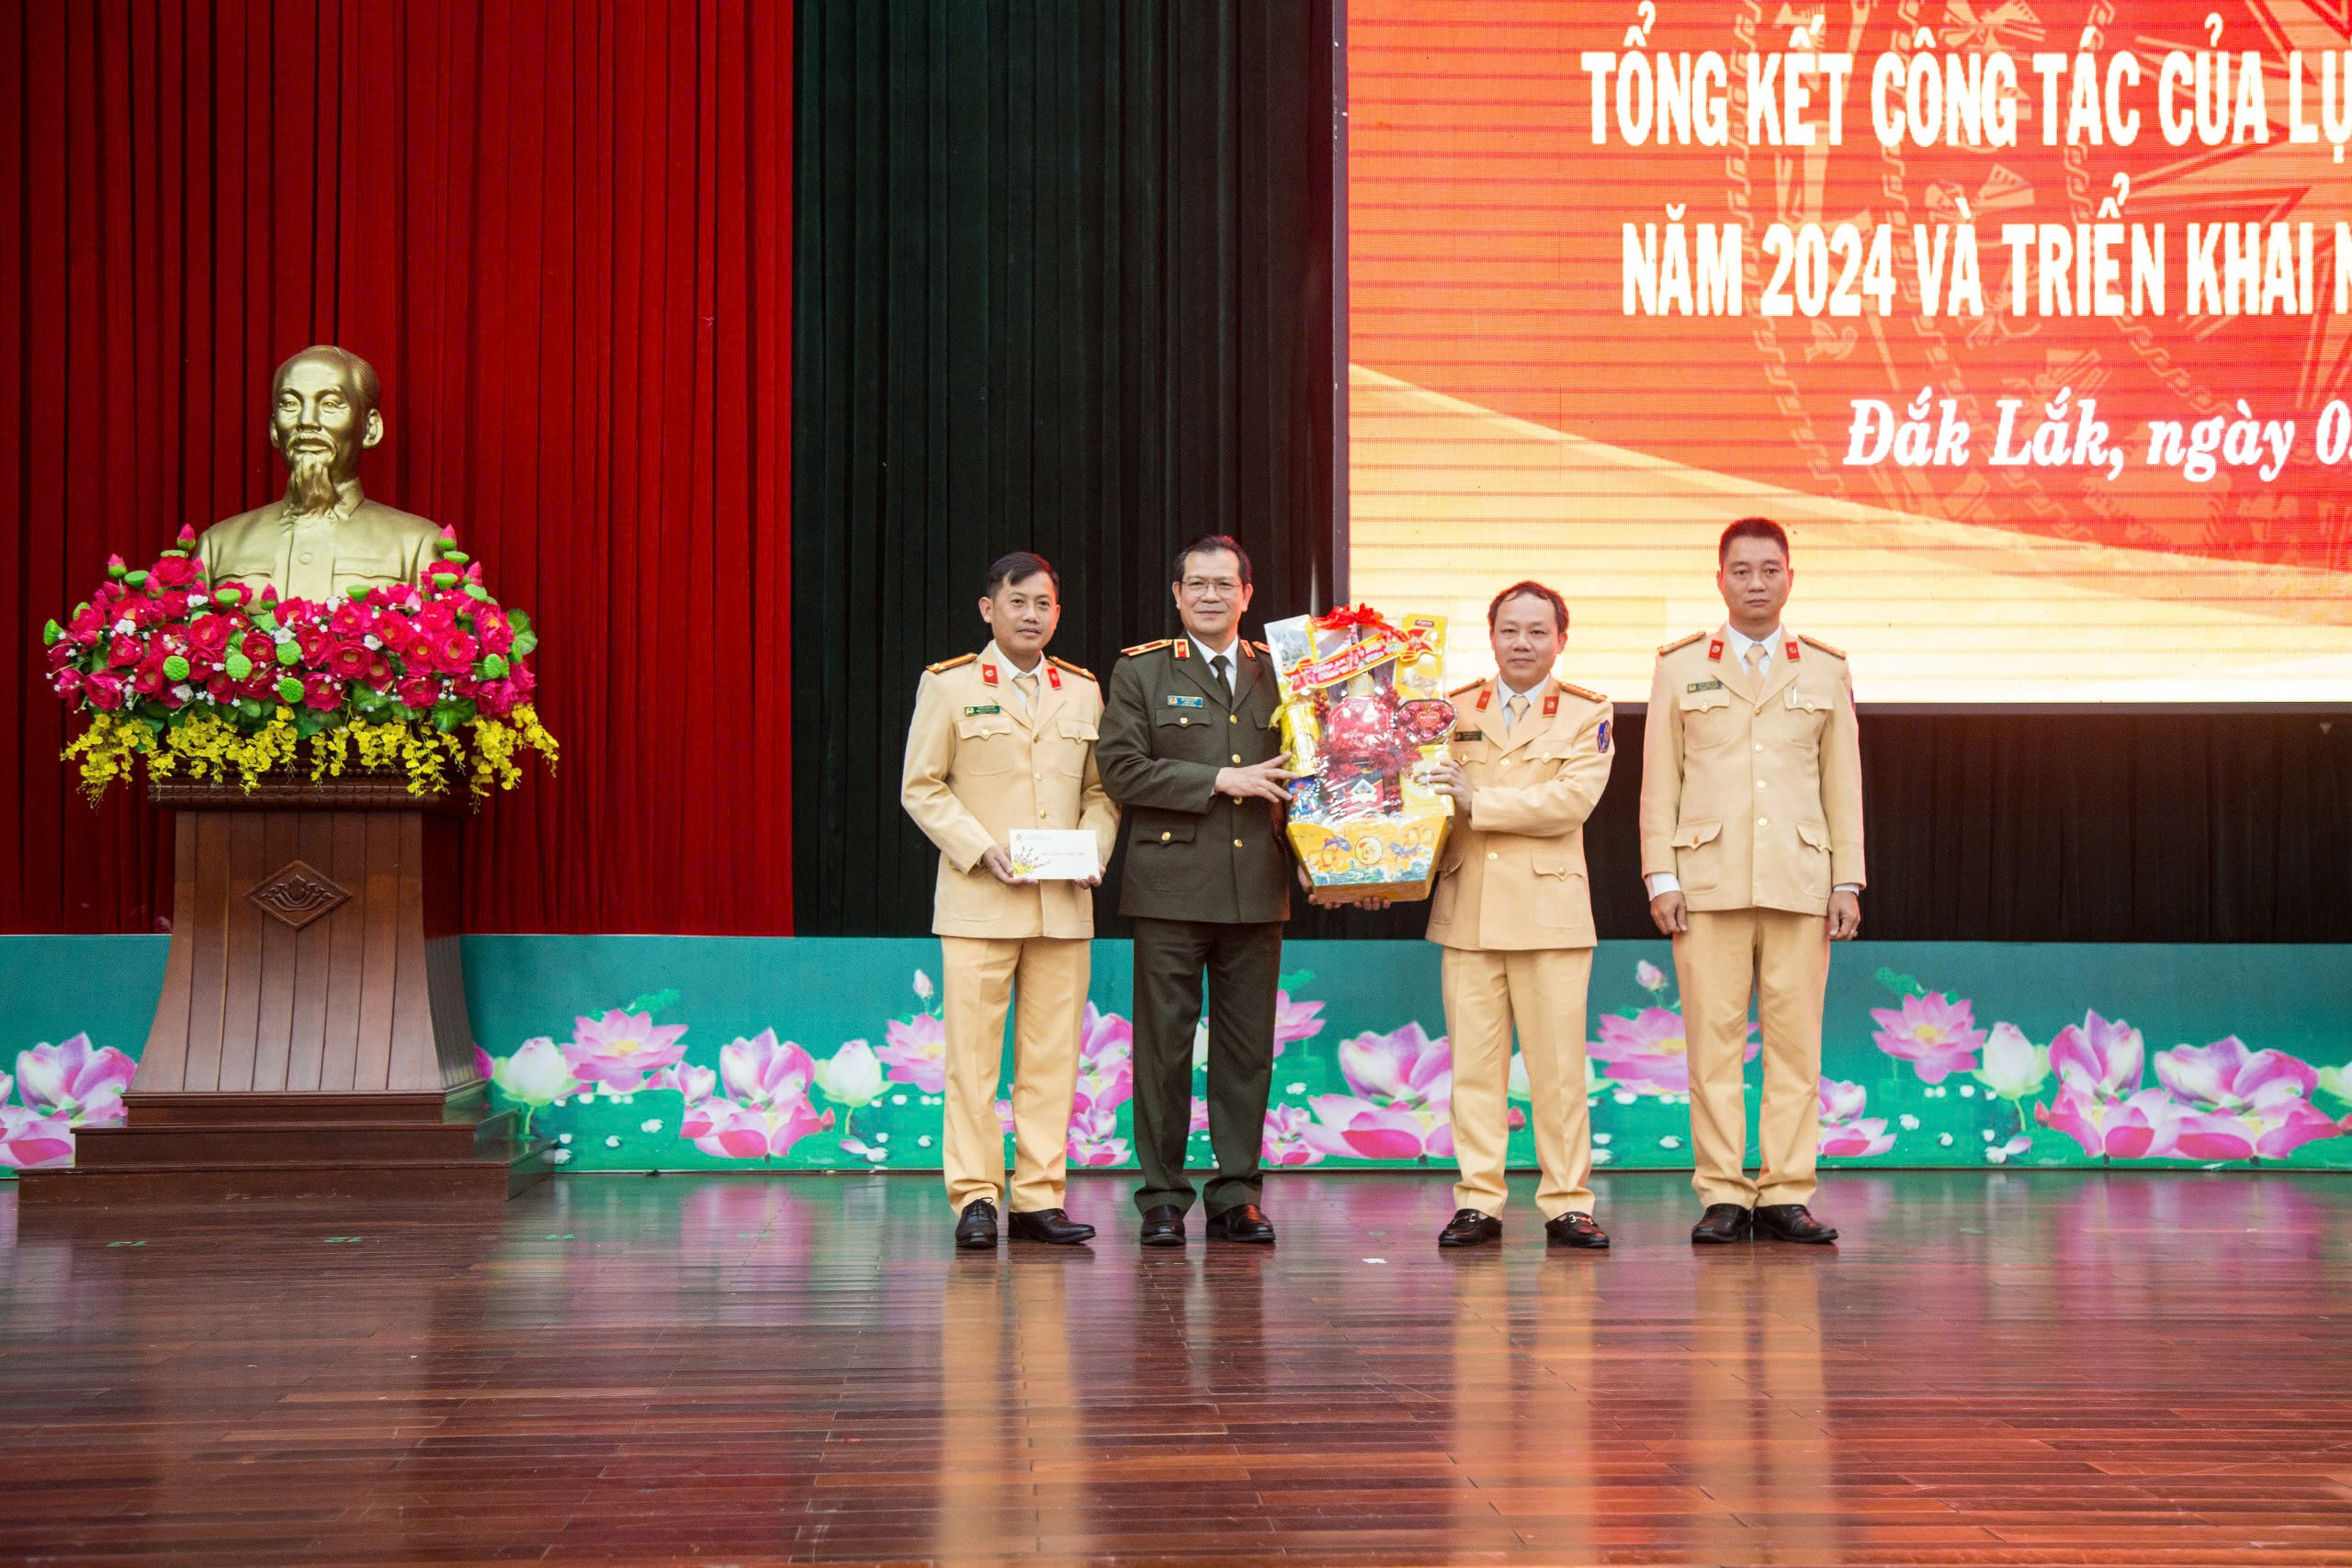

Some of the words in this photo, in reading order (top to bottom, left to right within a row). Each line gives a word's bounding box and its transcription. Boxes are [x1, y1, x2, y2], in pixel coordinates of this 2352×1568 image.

[1581, 1, 1728, 145] TỔNG
[1747, 15, 1853, 145] KẾT
[1871, 28, 2018, 147] CÔNG
[2032, 27, 2141, 145] TÁC
[2159, 14, 2269, 145] CỦA
[1623, 204, 1742, 316] NĂM
[1760, 223, 1896, 316] 2024
[1914, 197, 1984, 316] VÀ
[2002, 173, 2165, 316] TRIỂN
[2188, 222, 2313, 314] KHAI
[1843, 387, 1970, 467] Đắk
[1989, 387, 2124, 480] Lắk,
[2146, 400, 2296, 482] ngày
[2316, 400, 2352, 465] 0
